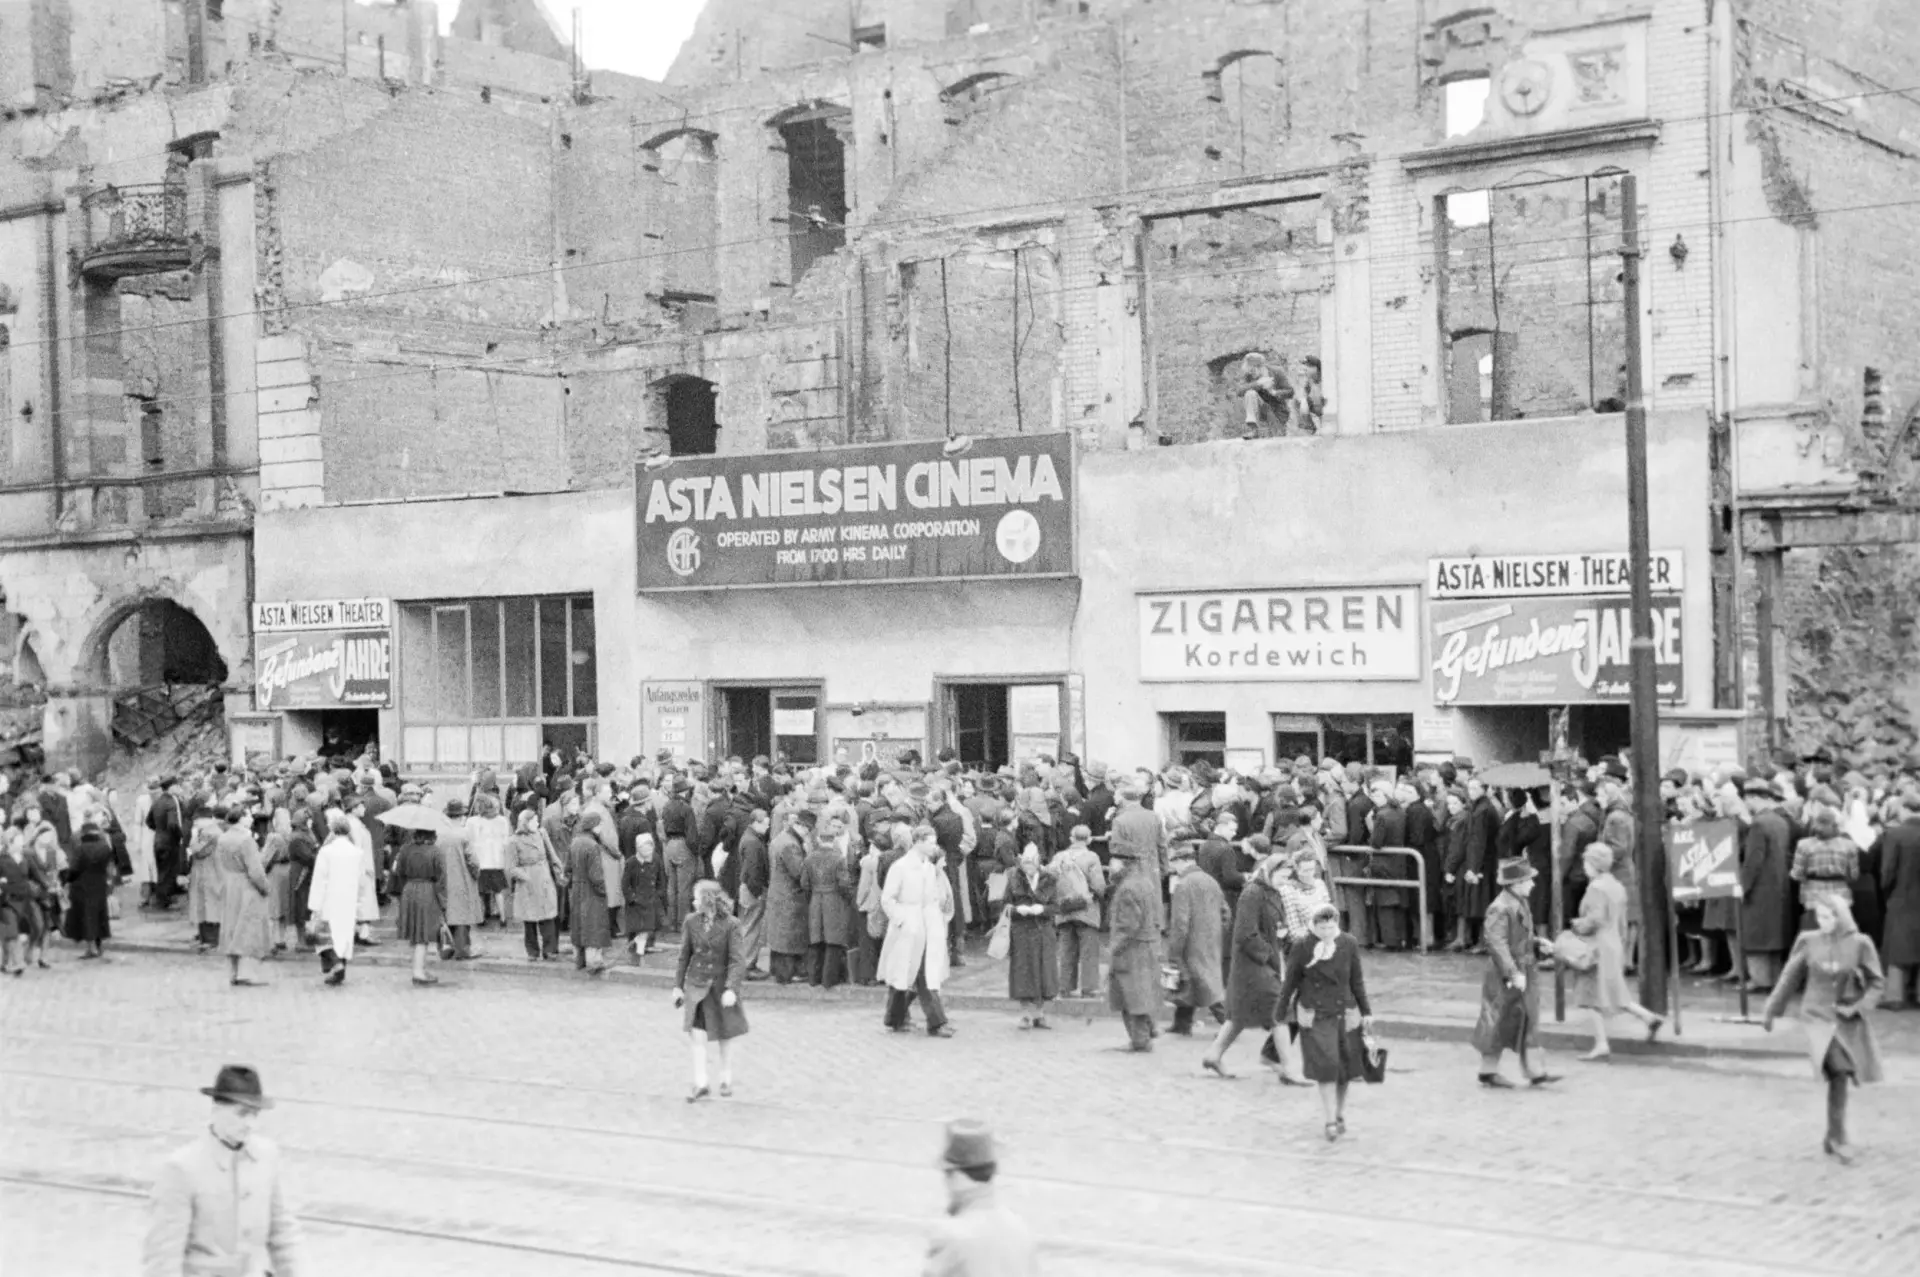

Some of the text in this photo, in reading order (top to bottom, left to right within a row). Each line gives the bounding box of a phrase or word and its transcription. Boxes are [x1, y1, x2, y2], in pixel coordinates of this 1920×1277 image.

[644, 454, 1064, 523] ASTA NIELSEN CINEMA
[717, 518, 981, 547] OPERATED BY ARMY KINEMA CORPORATION
[776, 544, 907, 565] FROM 1700 HRS DAILY
[1437, 555, 1670, 590] ASTA NIELSEN THEAER
[260, 601, 384, 626] ASTA NIELSEN THEATER
[1149, 595, 1403, 634] ZIGARREN
[329, 638, 389, 699] JAHRE
[1185, 642, 1367, 667] Kordewich
[1432, 617, 1588, 701] Gefundene
